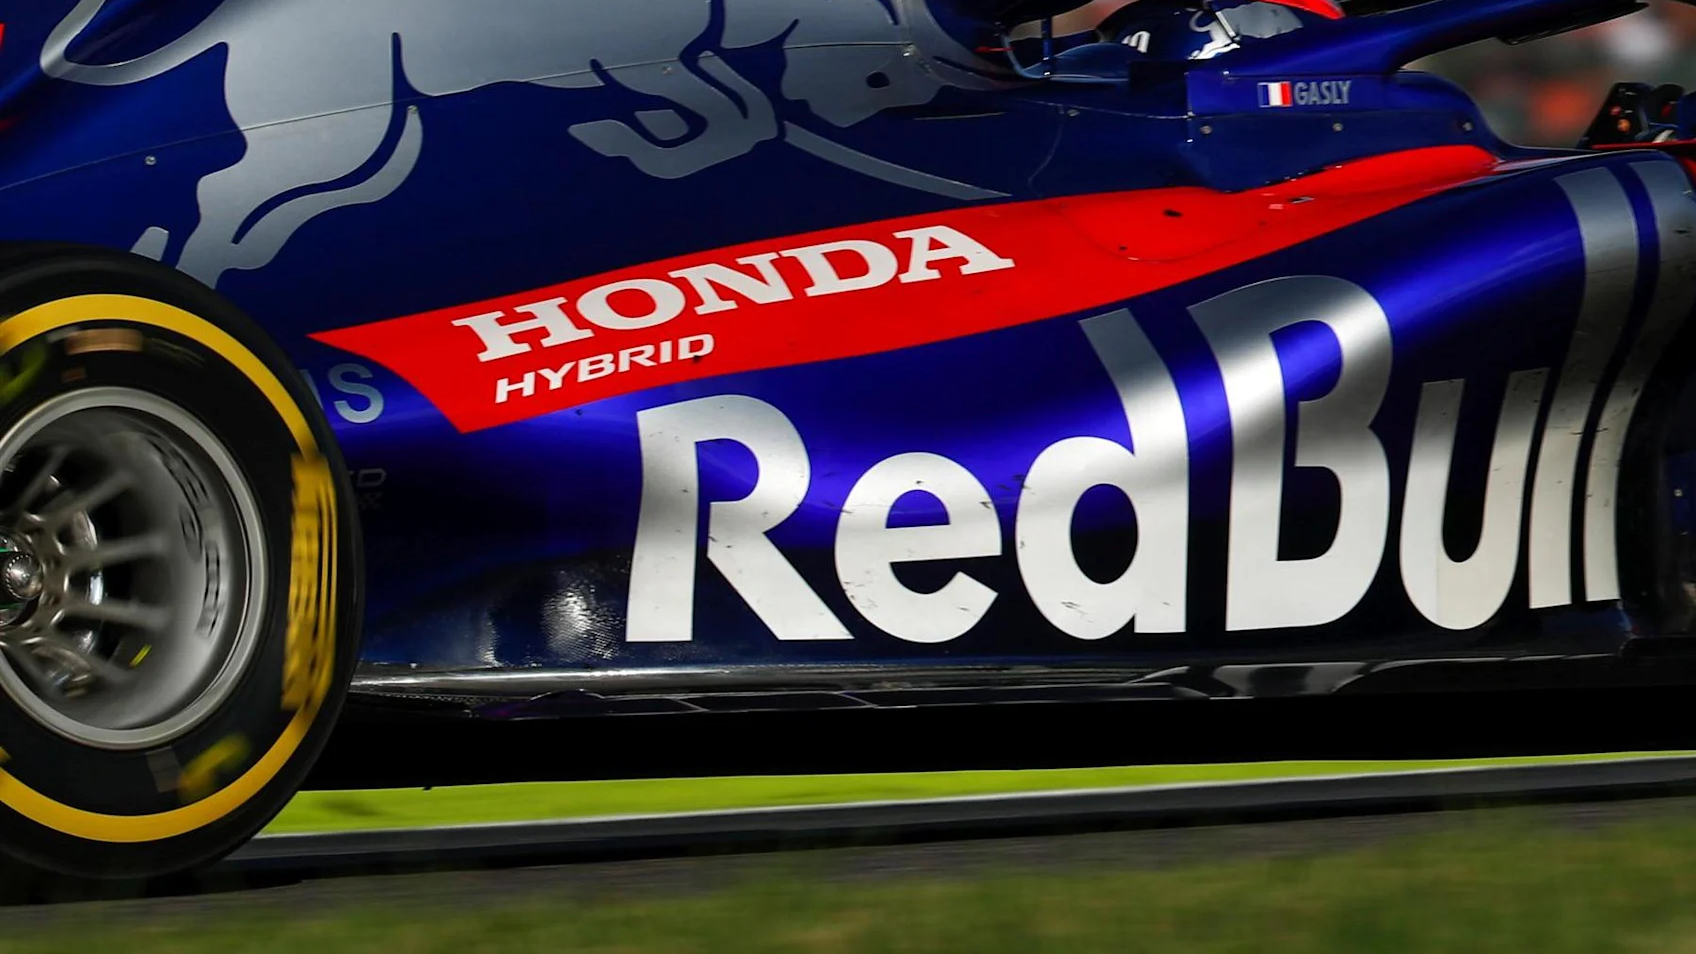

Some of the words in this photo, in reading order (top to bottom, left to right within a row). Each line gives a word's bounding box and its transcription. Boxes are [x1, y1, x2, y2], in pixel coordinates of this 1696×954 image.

[1294, 80, 1352, 106] GASLY
[452, 225, 1015, 362] HONDA
[494, 334, 715, 404] HYBRID
